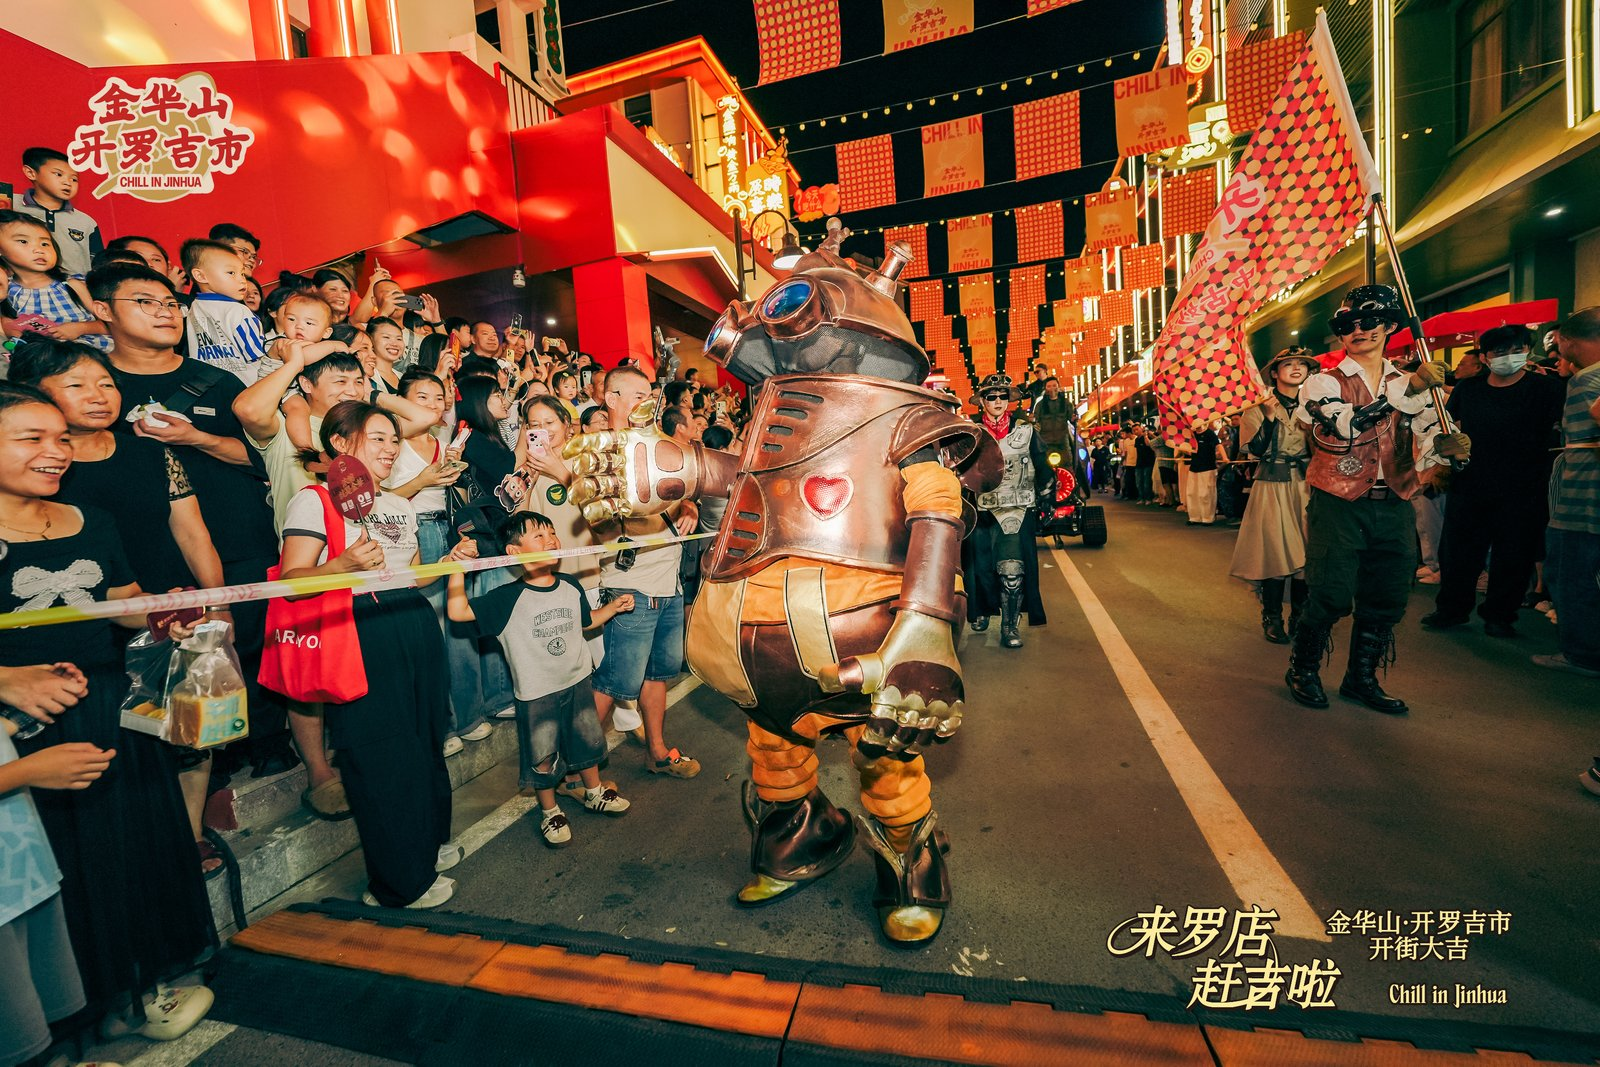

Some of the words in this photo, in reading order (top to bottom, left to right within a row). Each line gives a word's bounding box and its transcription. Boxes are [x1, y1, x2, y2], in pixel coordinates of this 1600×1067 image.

[1114, 72, 1163, 100] CHILL
[1169, 67, 1187, 87] IN
[967, 116, 983, 135] IN
[205, 584, 263, 604] LINE
[533, 607, 573, 627] WESTSIDE
